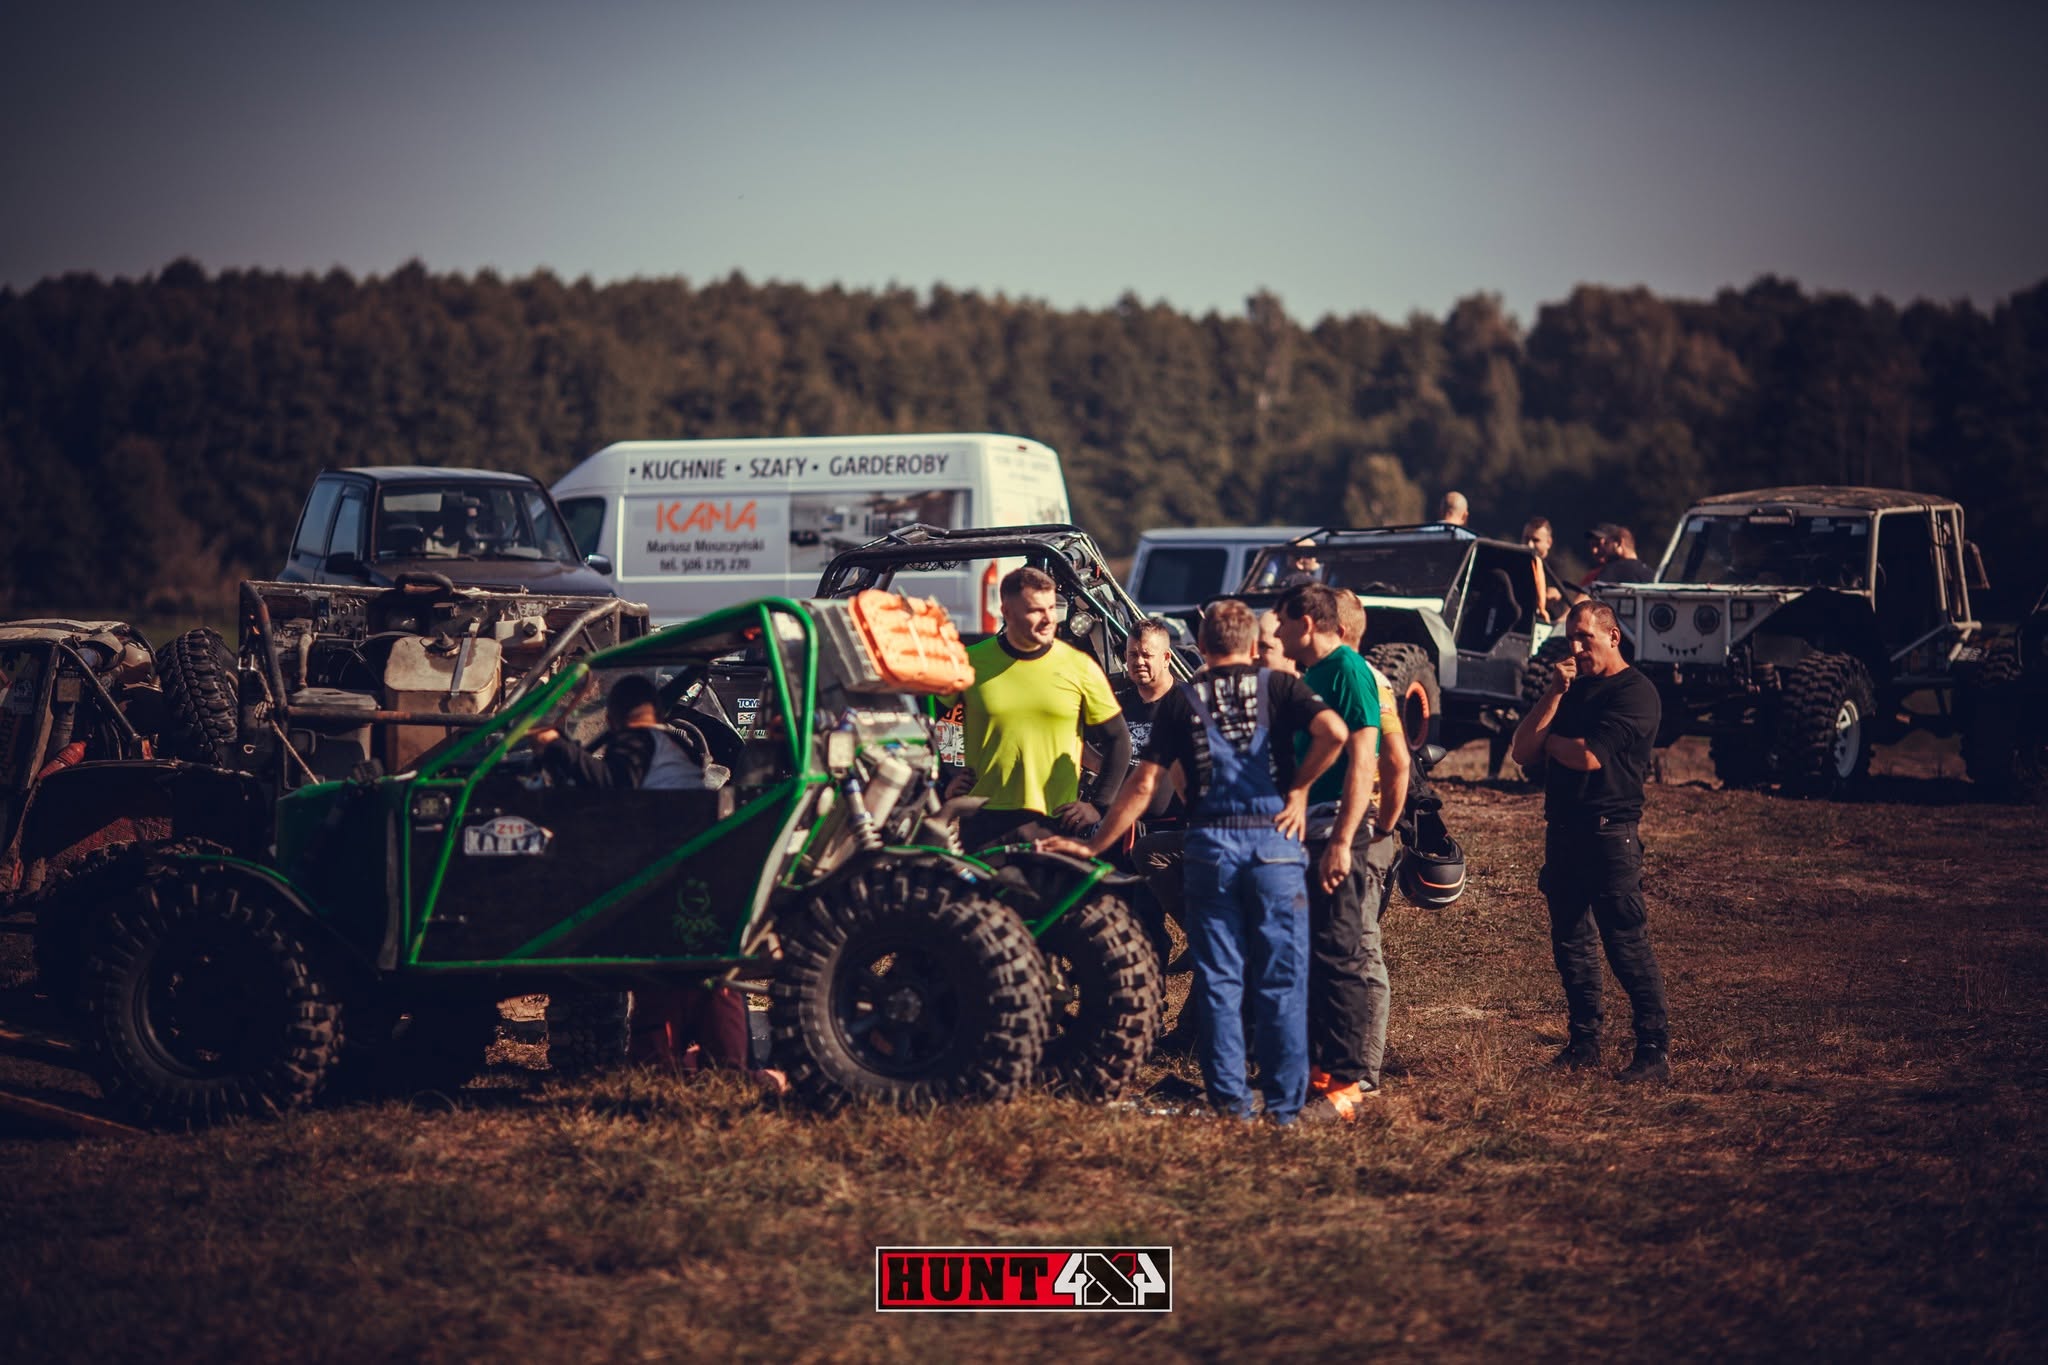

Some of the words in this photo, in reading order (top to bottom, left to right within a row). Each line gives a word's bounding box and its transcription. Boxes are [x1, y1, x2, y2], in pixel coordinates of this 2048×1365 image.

[641, 458, 727, 480] KUCHNIE
[749, 457, 807, 479] SZAFY
[829, 454, 949, 477] GARDEROBY
[646, 539, 692, 553] Mariusz
[659, 558, 679, 571] tel.
